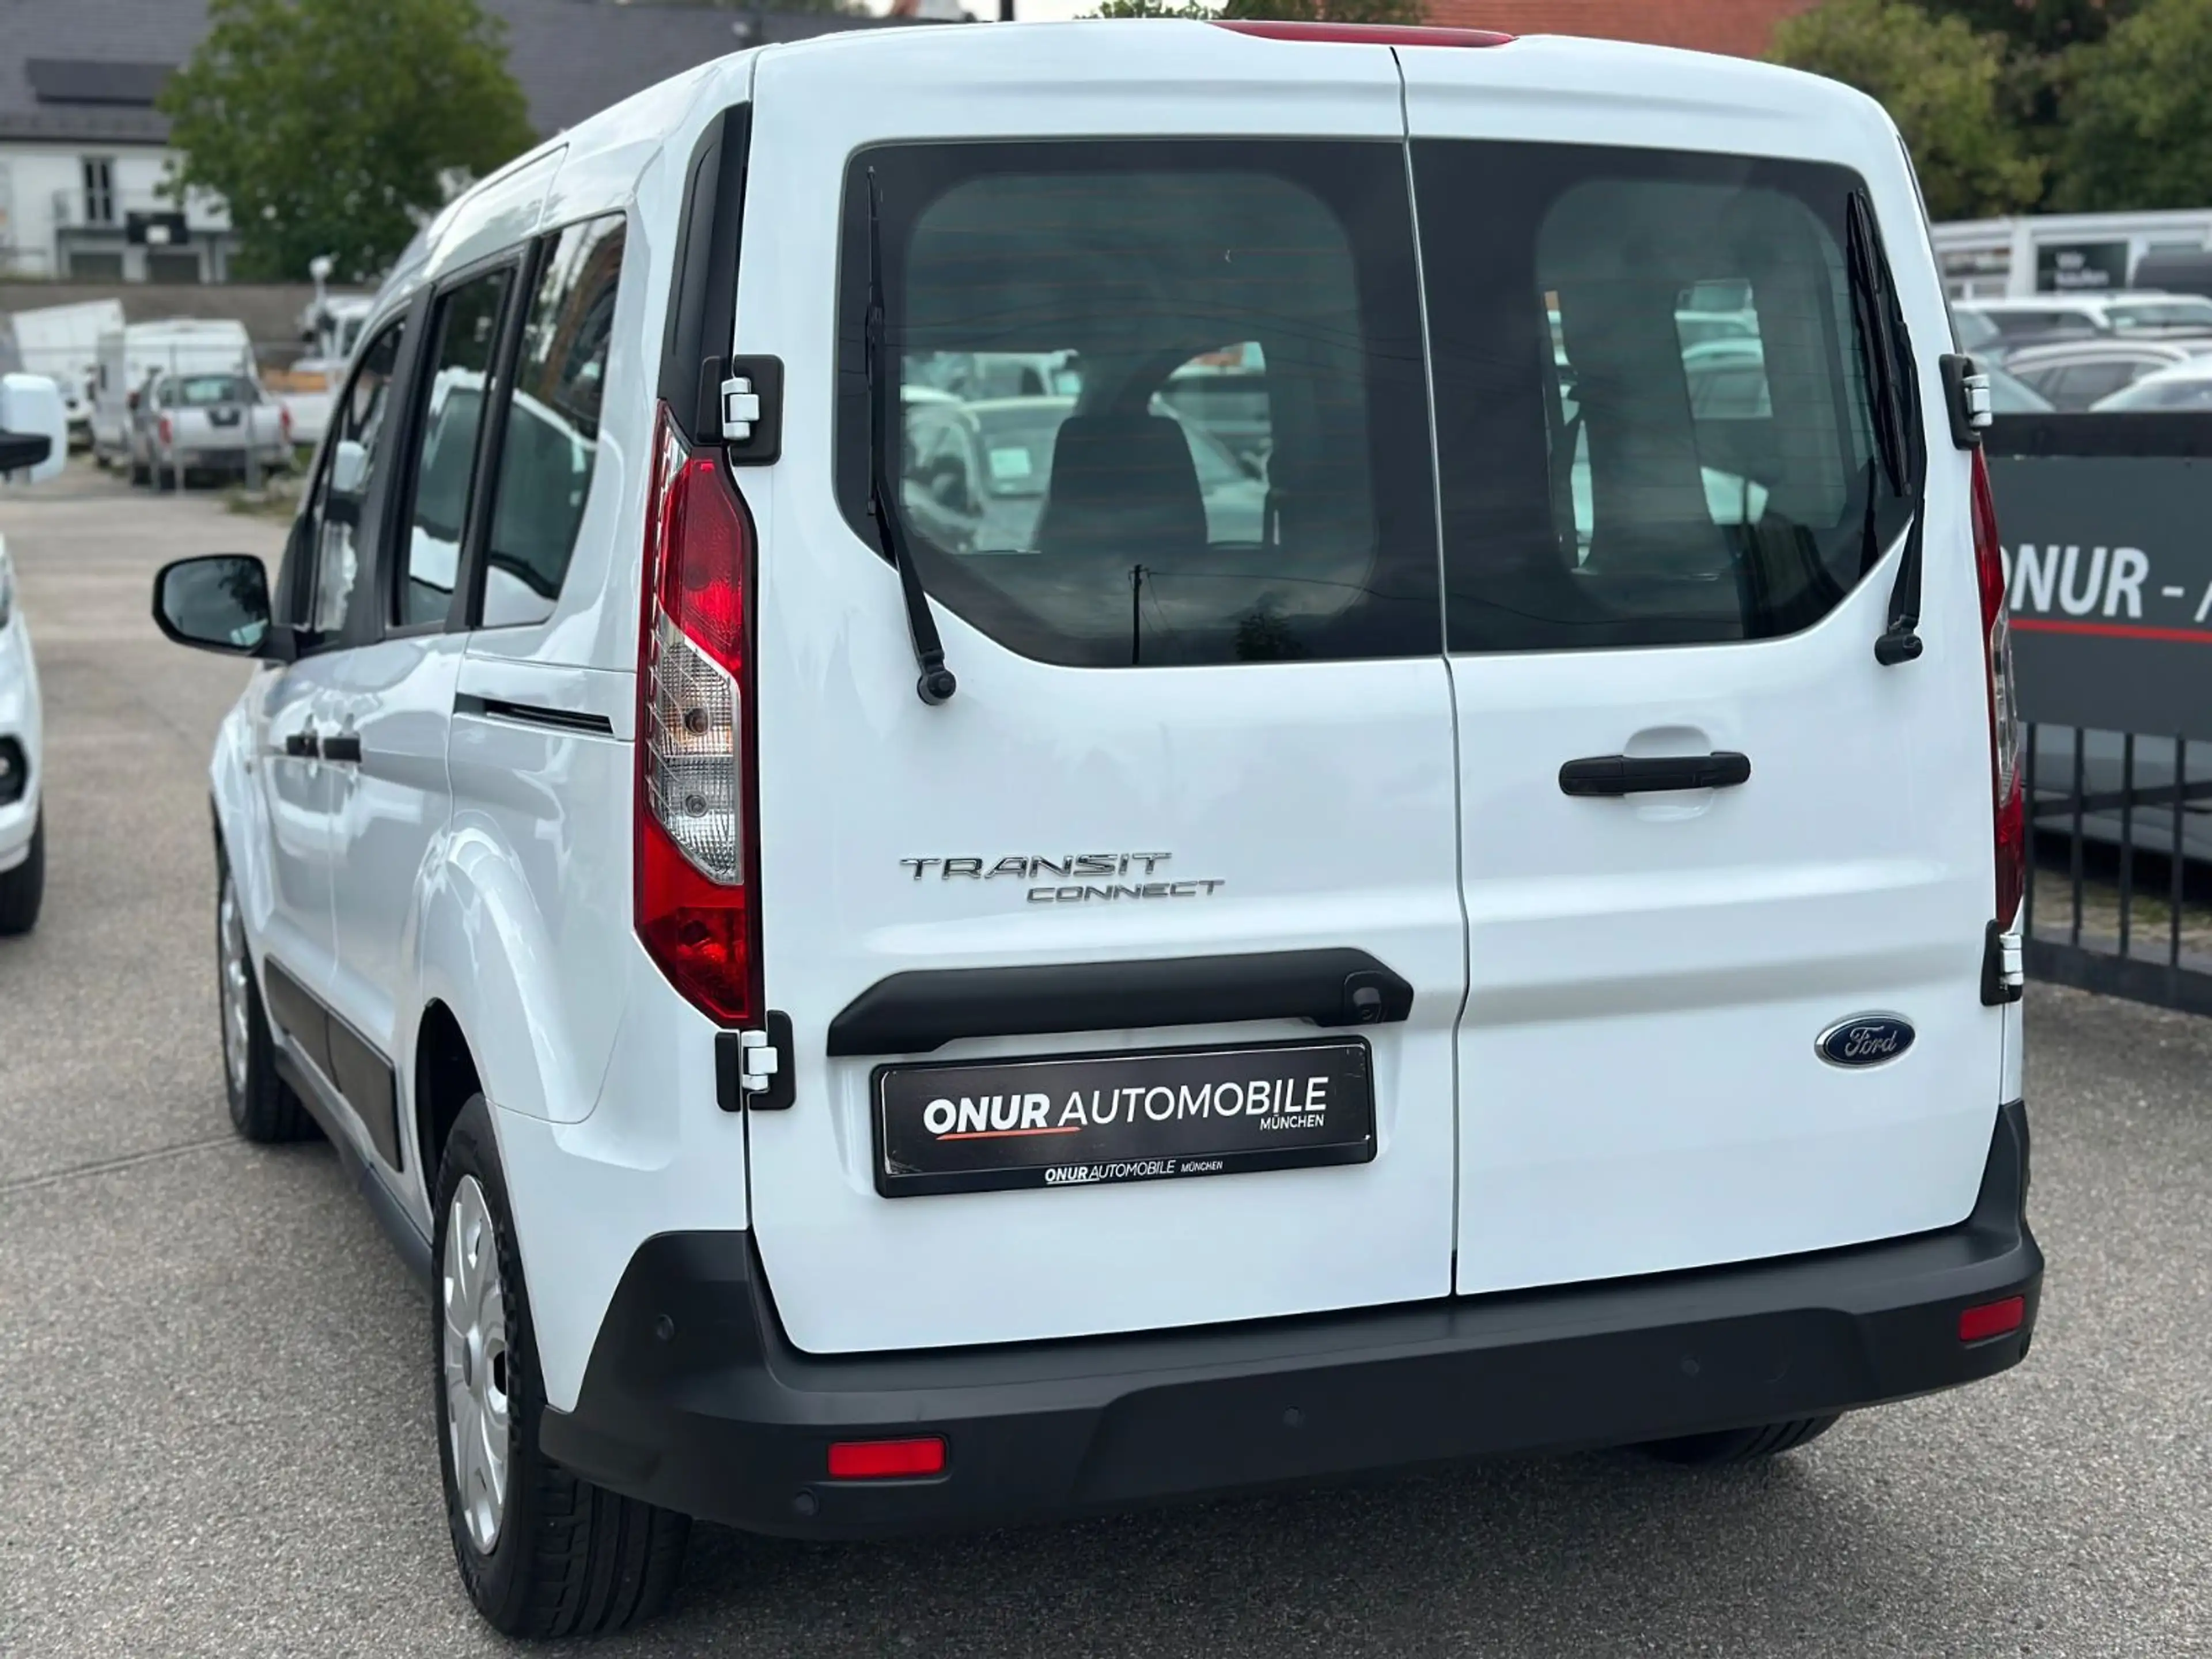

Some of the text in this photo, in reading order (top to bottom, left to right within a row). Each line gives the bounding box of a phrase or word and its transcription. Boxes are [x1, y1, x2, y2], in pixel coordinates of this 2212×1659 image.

[900, 851, 1172, 880] TRANSIT
[1027, 880, 1225, 903] CONNECT
[1844, 1025, 1898, 1056] Ford
[923, 1076, 1330, 1134] ONUR AUTOMOBILE
[1259, 1114, 1325, 1131] MÜNCHEN
[1180, 1161, 1224, 1173] MÜNCHEN
